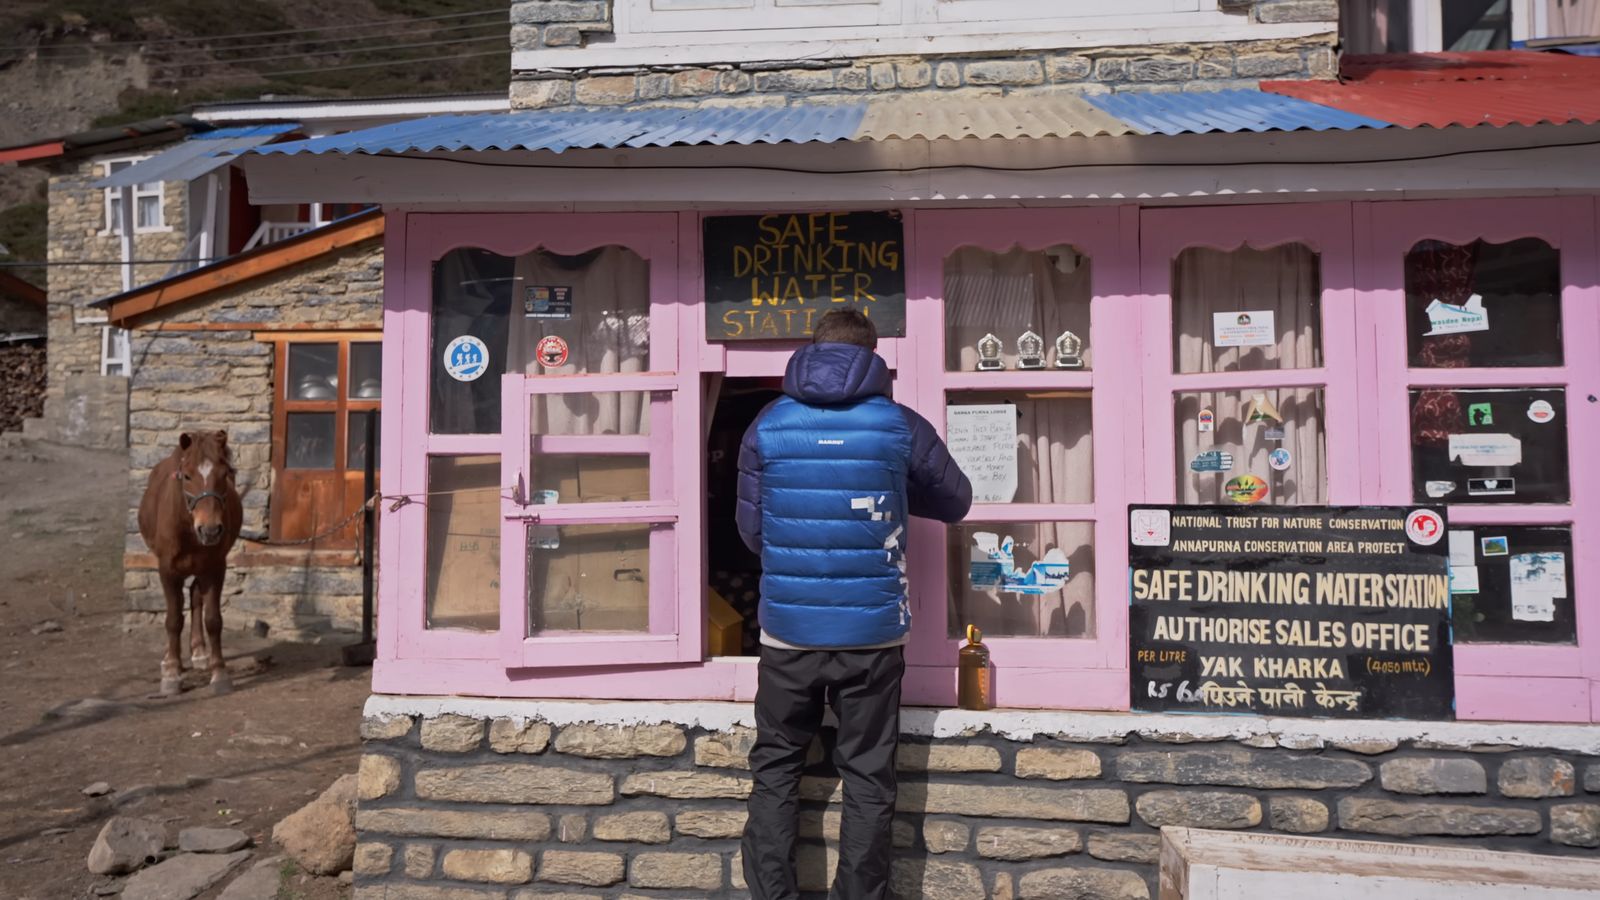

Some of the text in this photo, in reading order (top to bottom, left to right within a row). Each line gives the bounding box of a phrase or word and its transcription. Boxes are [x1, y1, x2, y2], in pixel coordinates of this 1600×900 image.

[758, 211, 849, 245] SAFE
[733, 241, 899, 278] DRINKING
[751, 273, 876, 307] WATER
[723, 306, 870, 337] STATI
[1172, 516, 1404, 530] NATIONAL TRUST FOR NATURE CONSERVATION
[1172, 540, 1405, 554] ANNAPURNA CONSERVATION AREA PROJECT
[1133, 569, 1192, 601] SAFE
[1197, 570, 1311, 604] DRINKING
[1153, 615, 1430, 651] AUTHORISE SALES OFFICE
[1137, 650, 1187, 664] PER LITRE
[1200, 655, 1344, 679] YAK KHARKA
[1257, 681, 1307, 709] पानी
[1311, 681, 1362, 712] केन्द्र
